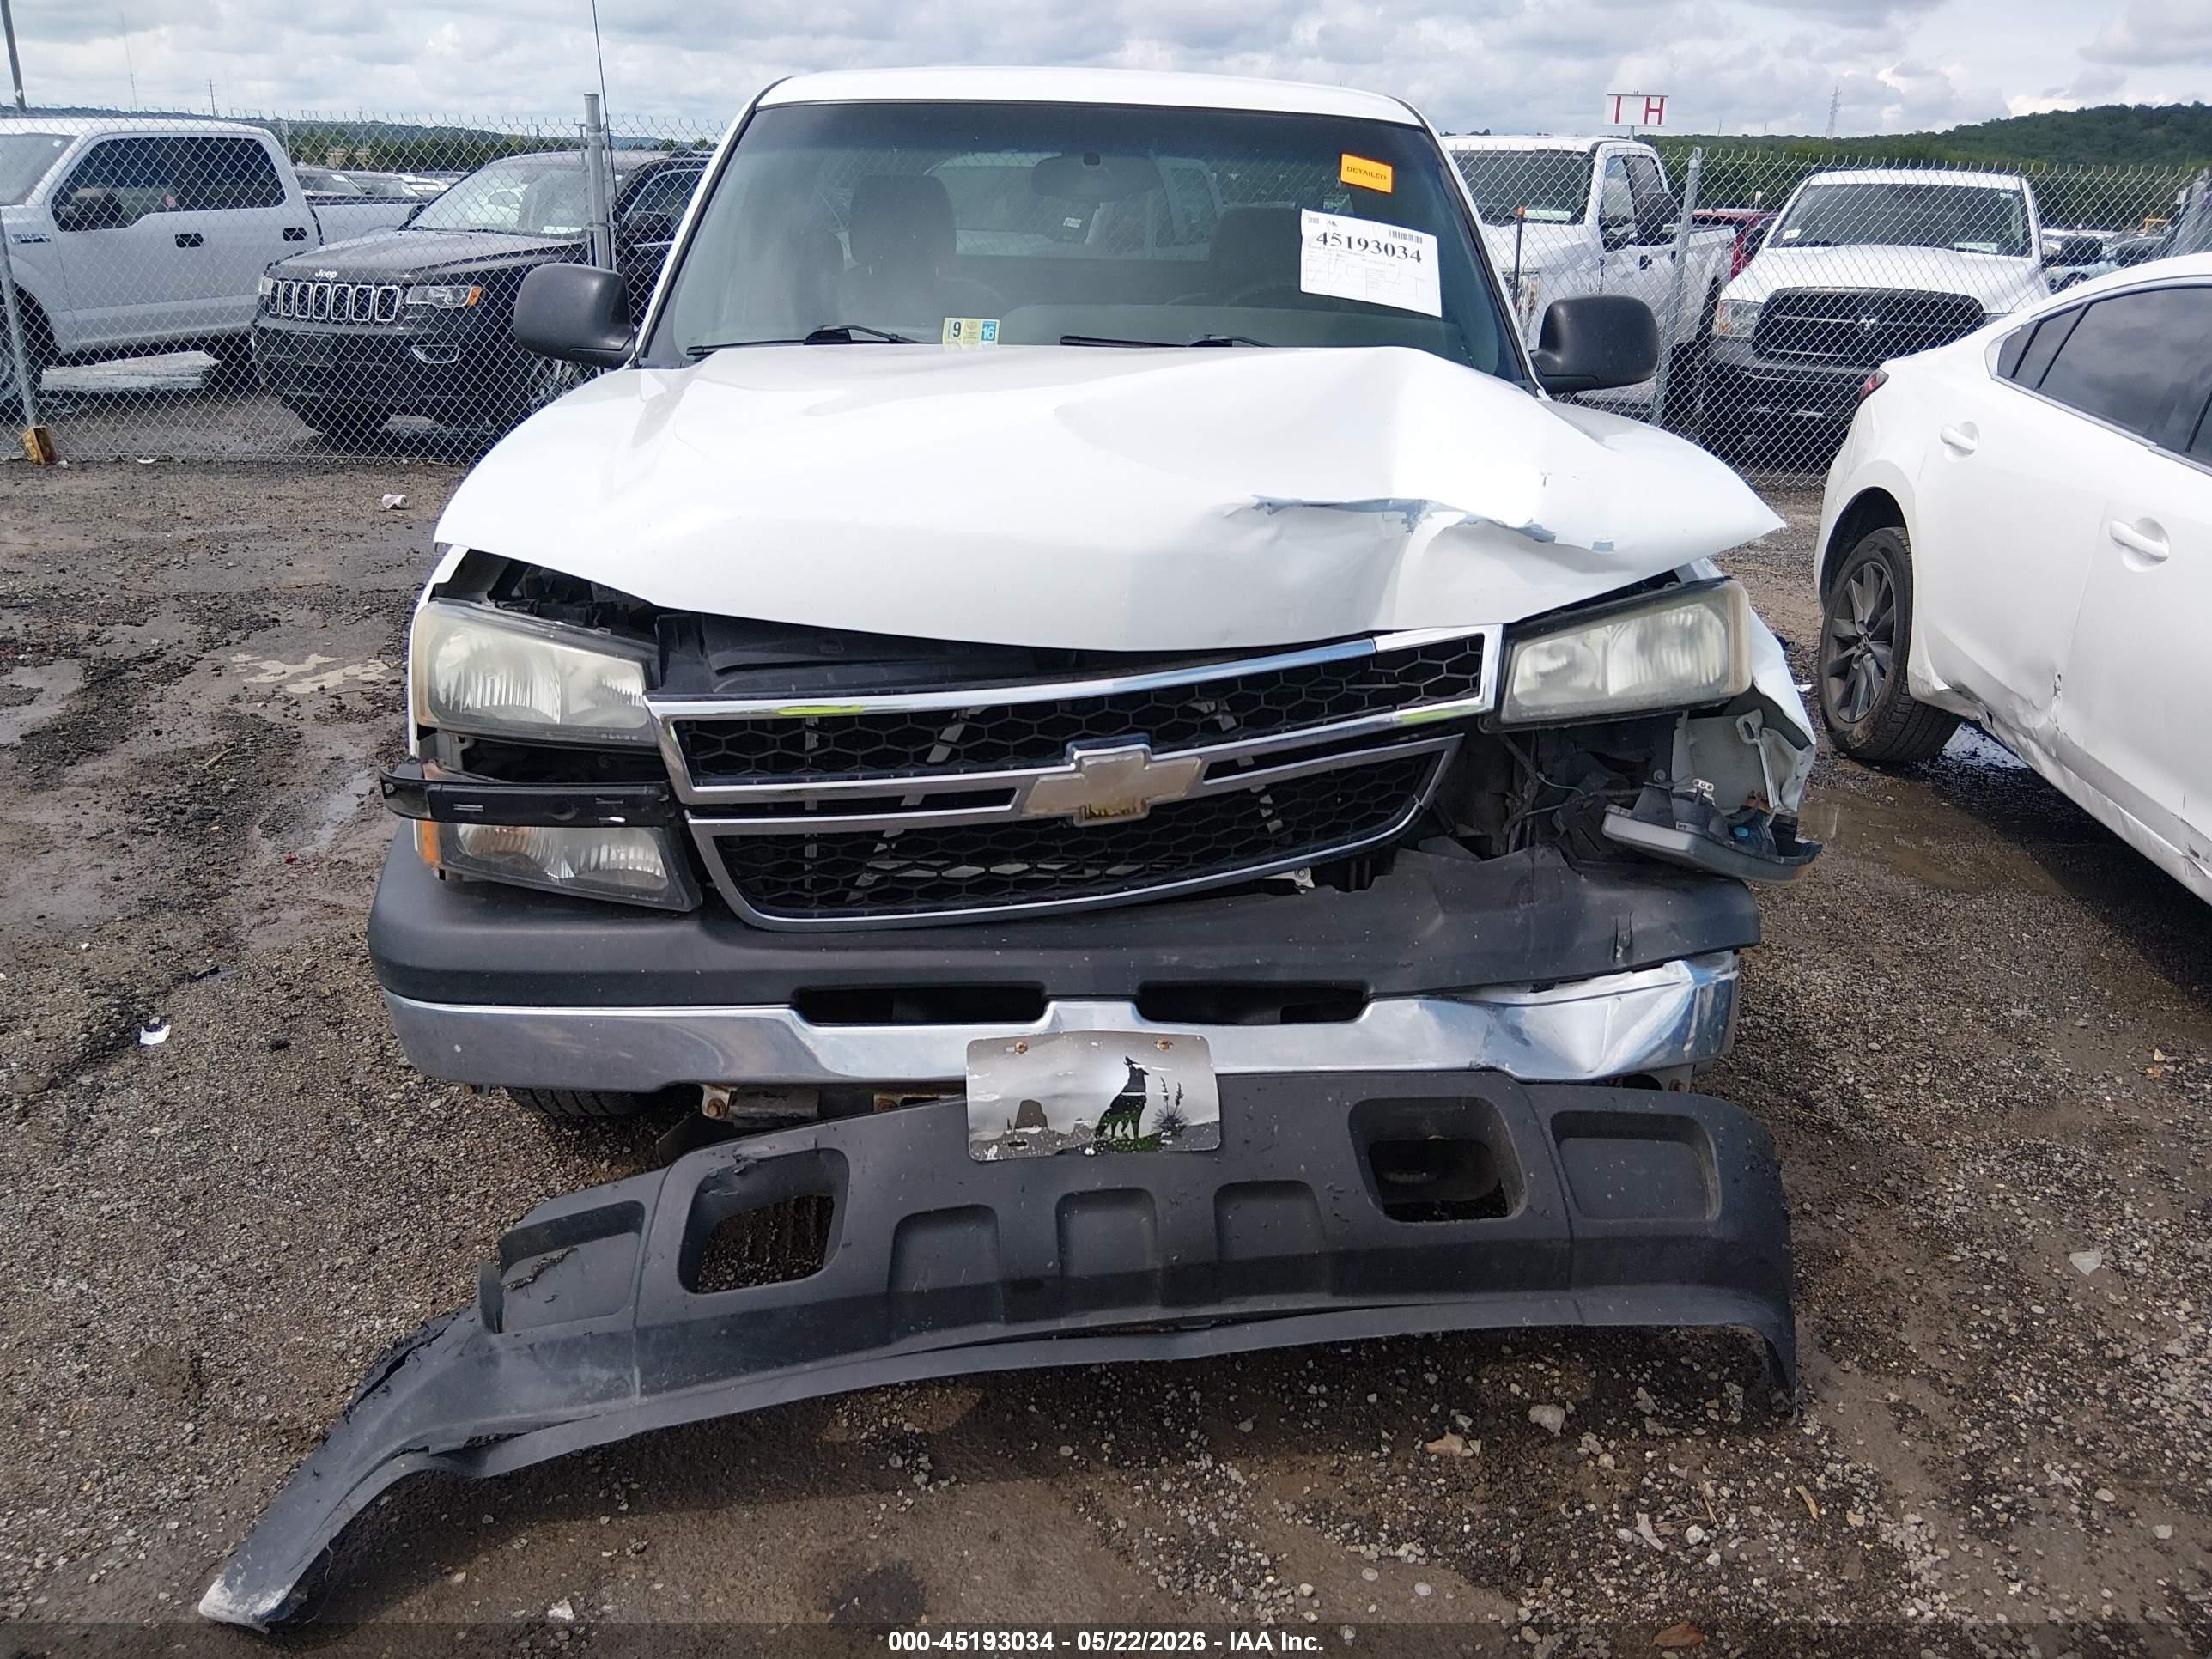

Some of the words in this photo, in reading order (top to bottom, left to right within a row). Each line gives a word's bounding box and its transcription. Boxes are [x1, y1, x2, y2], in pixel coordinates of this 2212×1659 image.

[1644, 95, 1665, 125] H
[1346, 165, 1388, 180] DETAILED
[1316, 231, 1423, 264] 45193034
[314, 268, 337, 281] Jeep
[952, 321, 962, 337] 9
[982, 325, 996, 340] 16
